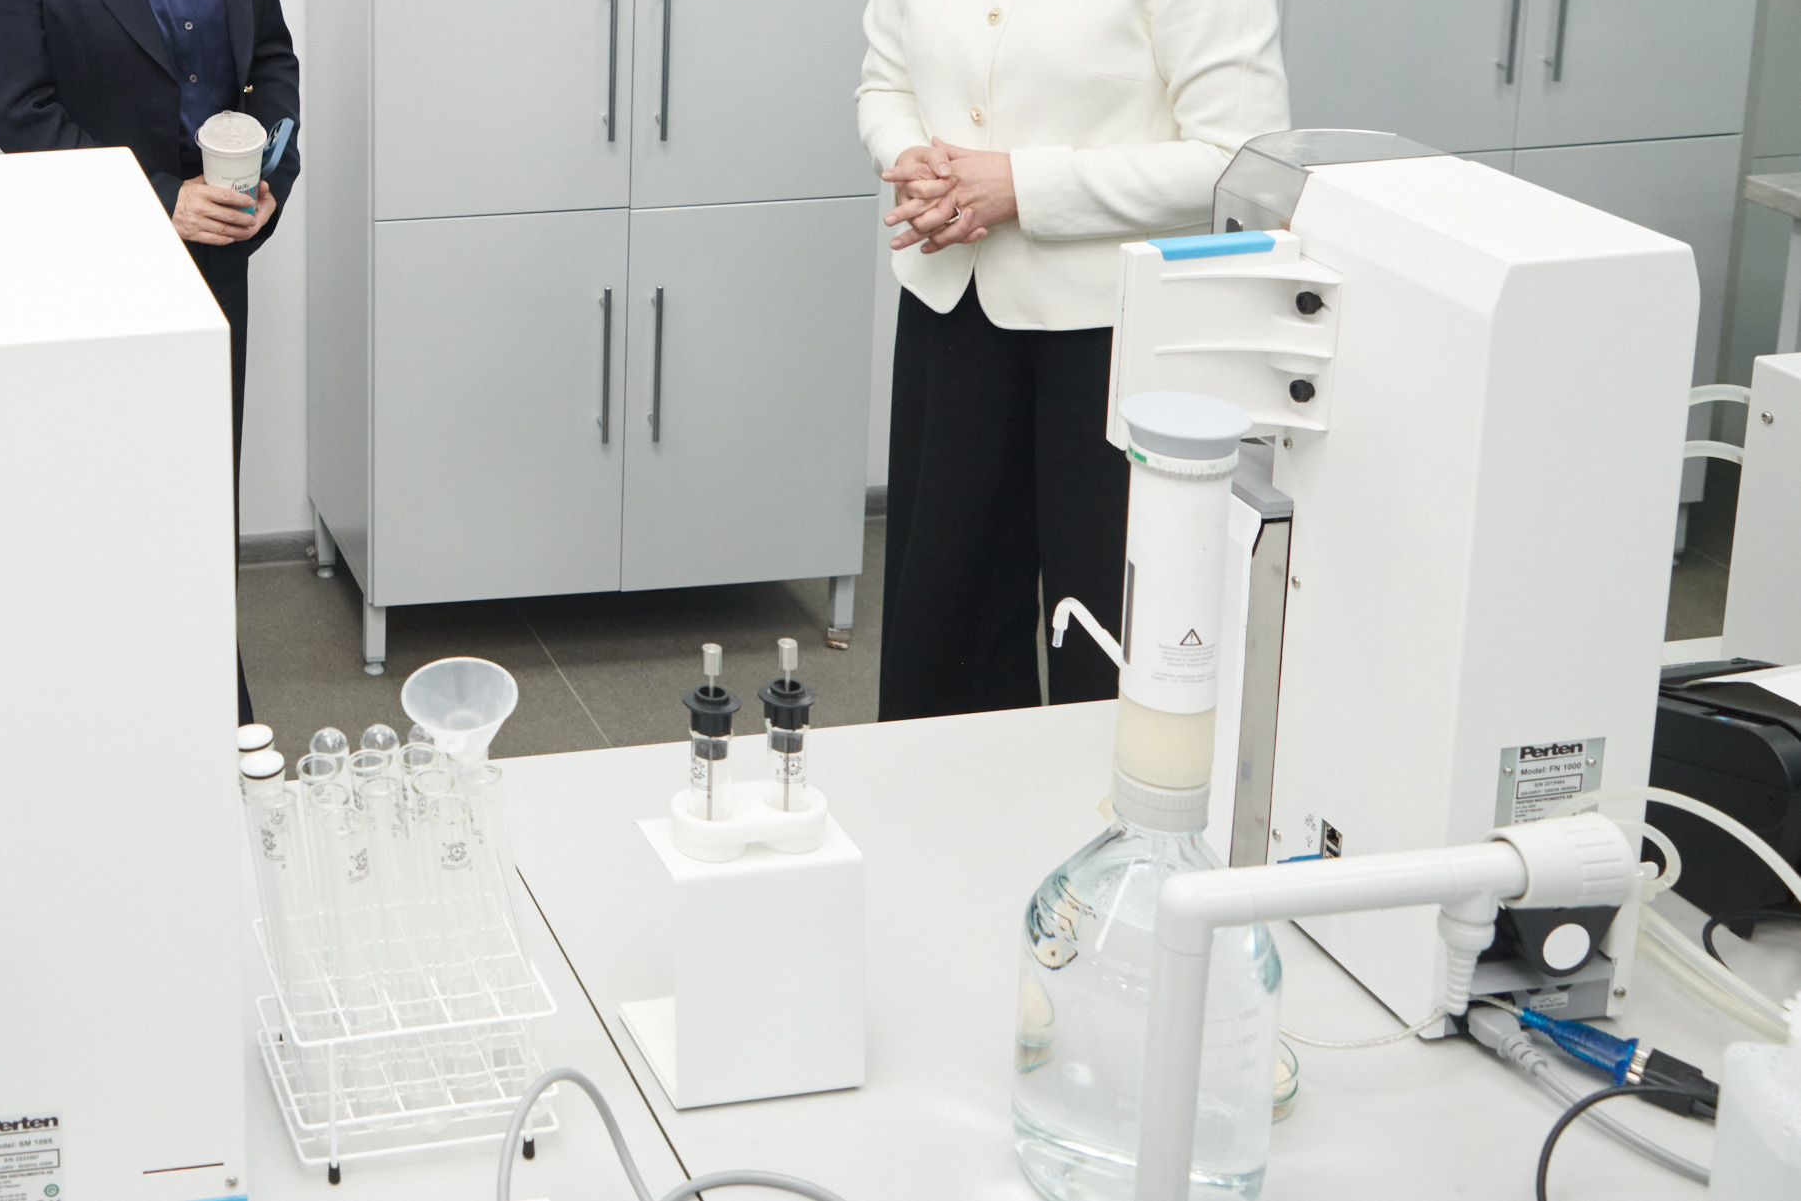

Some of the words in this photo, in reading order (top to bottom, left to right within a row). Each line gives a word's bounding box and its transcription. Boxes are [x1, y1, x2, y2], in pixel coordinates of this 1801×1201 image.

[1520, 743, 1583, 760] Perten
[1521, 767, 1547, 775] Model:
[1564, 762, 1582, 770] 1000
